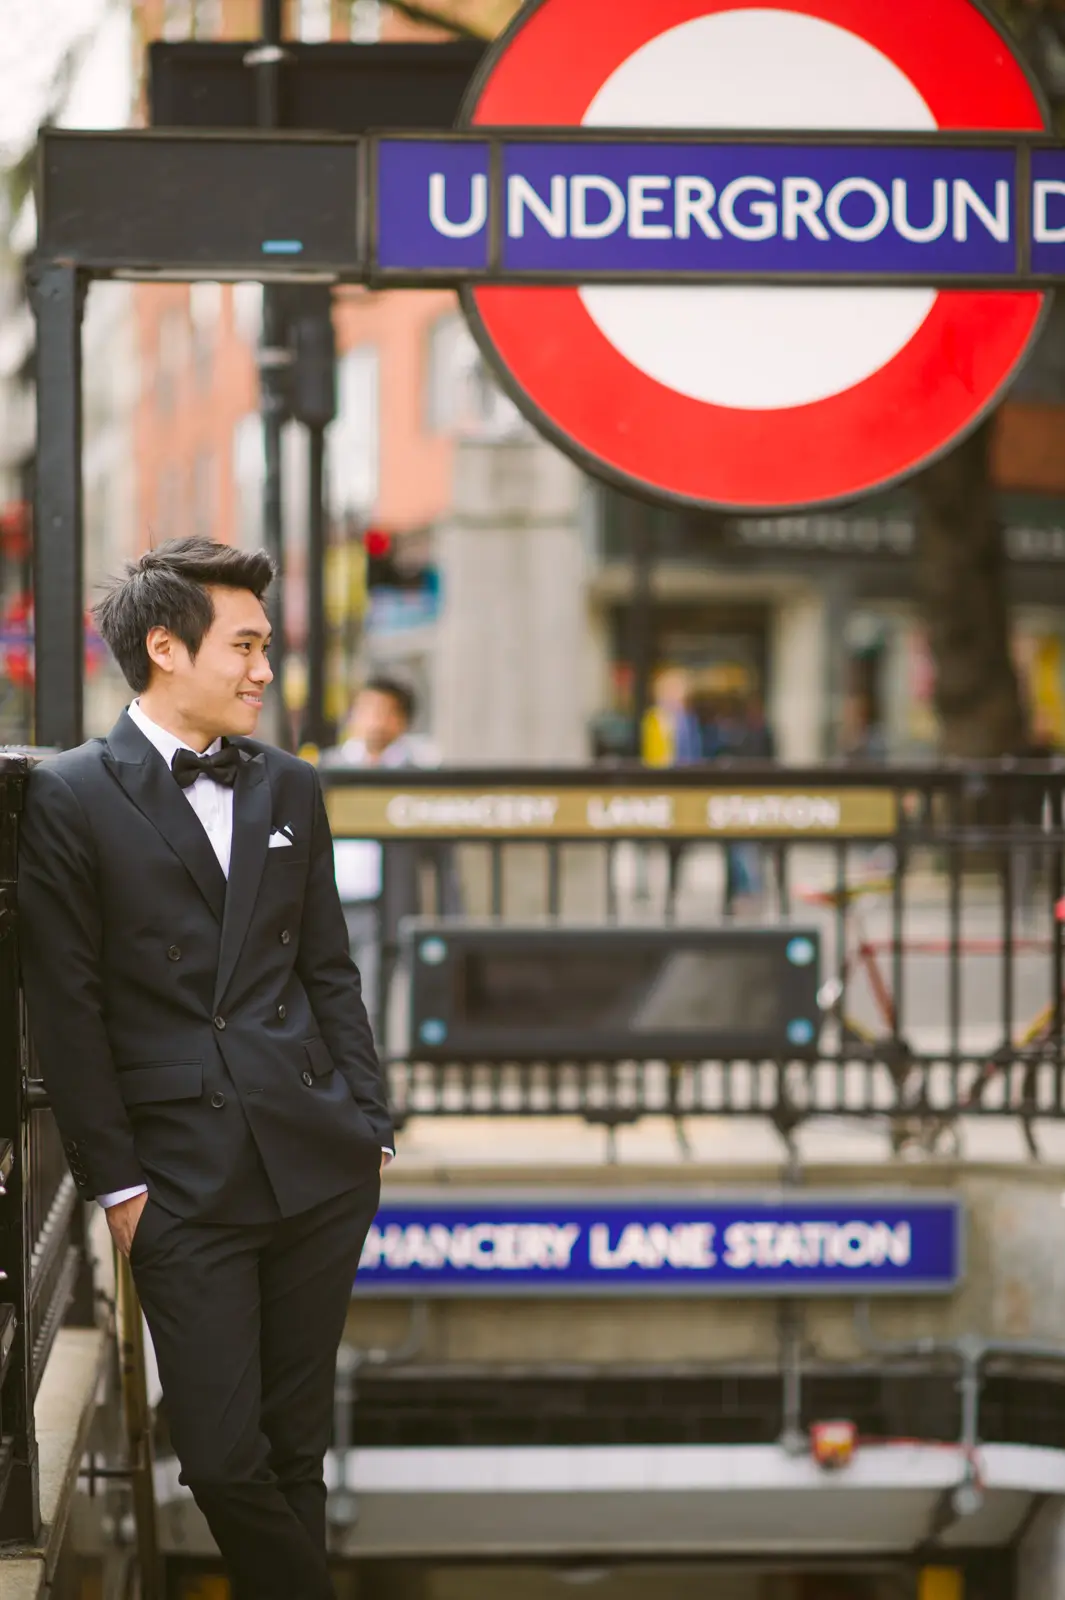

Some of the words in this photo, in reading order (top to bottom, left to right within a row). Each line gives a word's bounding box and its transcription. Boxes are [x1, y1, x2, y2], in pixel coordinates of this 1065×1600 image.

[428, 173, 1065, 243] UNDERGROUND
[359, 1222, 580, 1269] HANCERY
[589, 1222, 717, 1269] LANE
[722, 1220, 911, 1268] STATION
